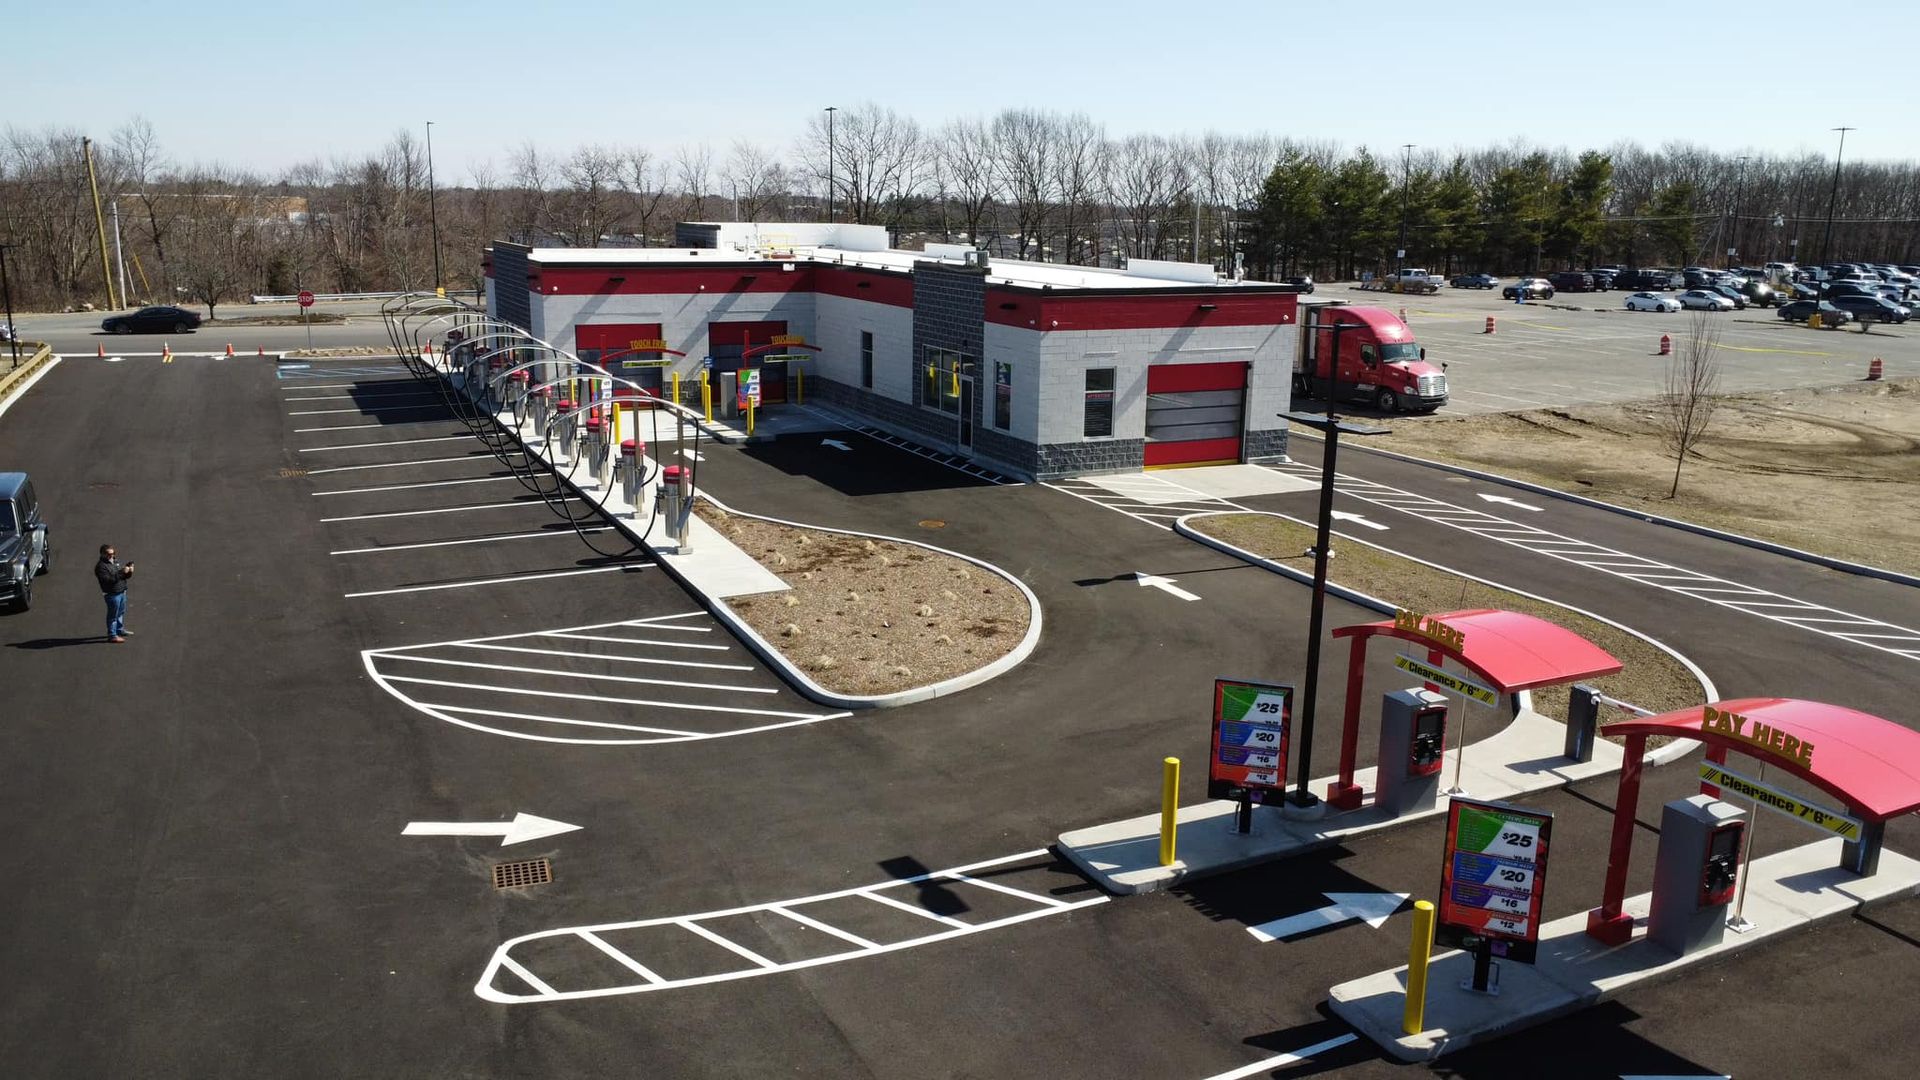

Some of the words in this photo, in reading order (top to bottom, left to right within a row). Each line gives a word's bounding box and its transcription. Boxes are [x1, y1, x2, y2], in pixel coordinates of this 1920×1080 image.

[298, 295, 314, 303] STOP
[1395, 608, 1424, 632] PAY
[1425, 617, 1465, 654] HERE
[1408, 661, 1456, 689] Clearance
[1257, 702, 1279, 714] $25
[1256, 732, 1275, 743] $20
[1701, 706, 1747, 735] PAY
[1752, 721, 1815, 771] HERE
[1720, 773, 1795, 813] Clearance
[1799, 803, 1834, 825] 7'6"
[1502, 832, 1533, 848] $25
[1501, 869, 1525, 883] $20
[1501, 898, 1518, 908] $16
[1501, 920, 1514, 929] $12
